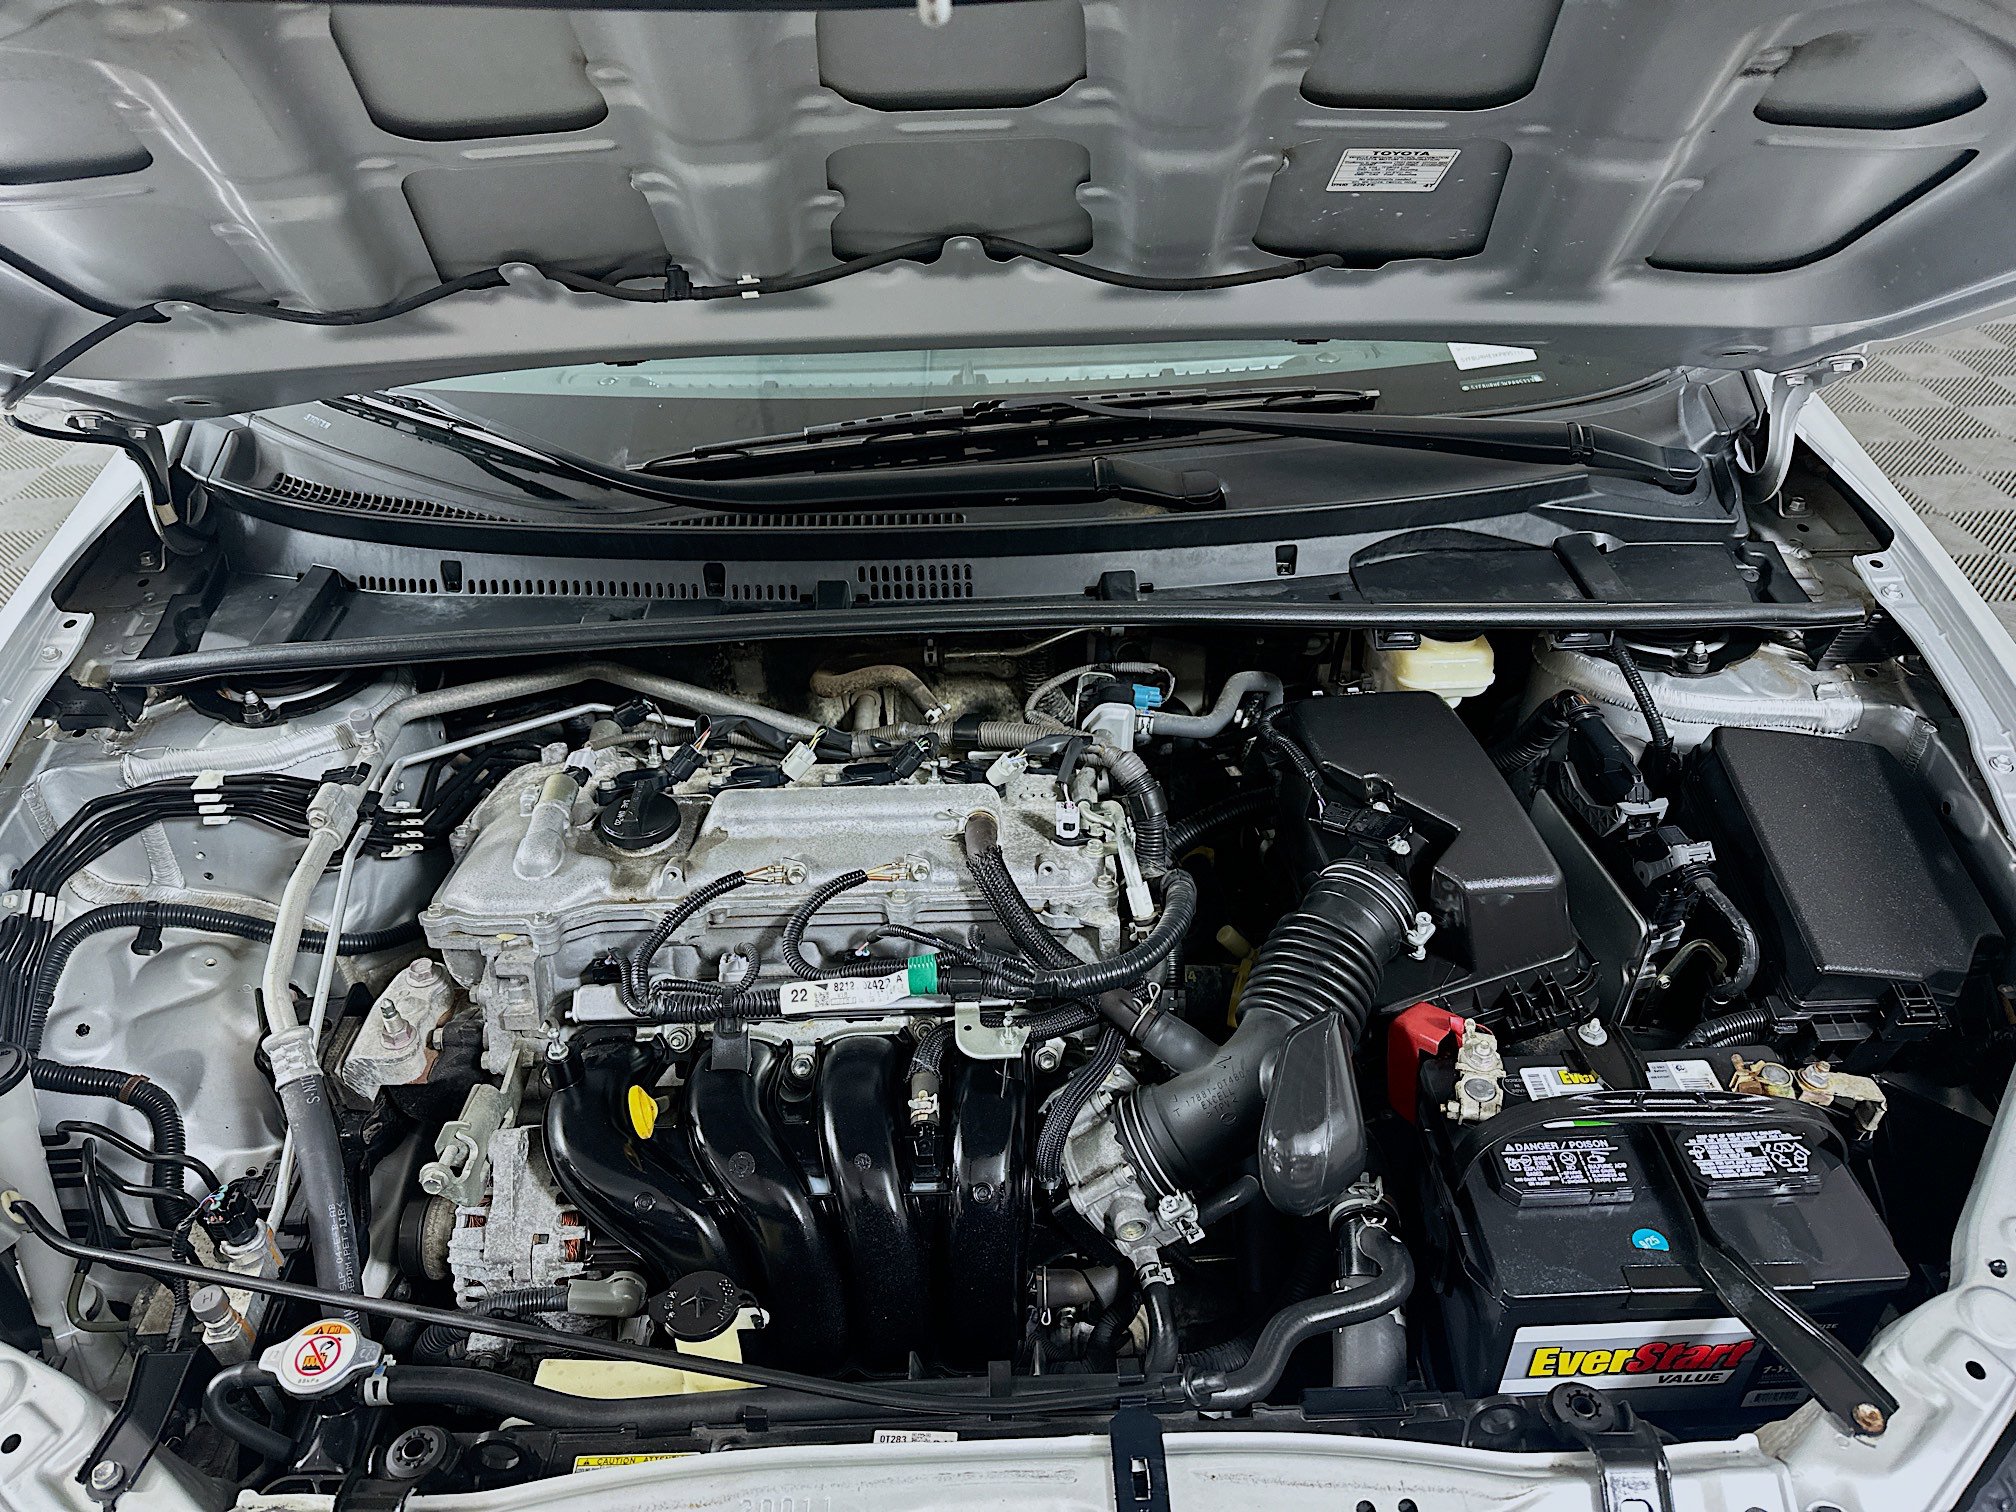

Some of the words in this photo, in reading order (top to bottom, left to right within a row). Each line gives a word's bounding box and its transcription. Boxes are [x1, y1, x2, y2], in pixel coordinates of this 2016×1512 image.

[791, 988, 808, 1003] 22
[1200, 1087, 1235, 1110] EXCELL
[1514, 1141, 1559, 1152] DANGER
[1568, 1139, 1609, 1149] POISON
[338, 1271, 348, 1291] SLP
[1527, 1340, 1755, 1378] EverStart
[1658, 1372, 1724, 1385] VALUE
[597, 1457, 636, 1466] CAUTION
